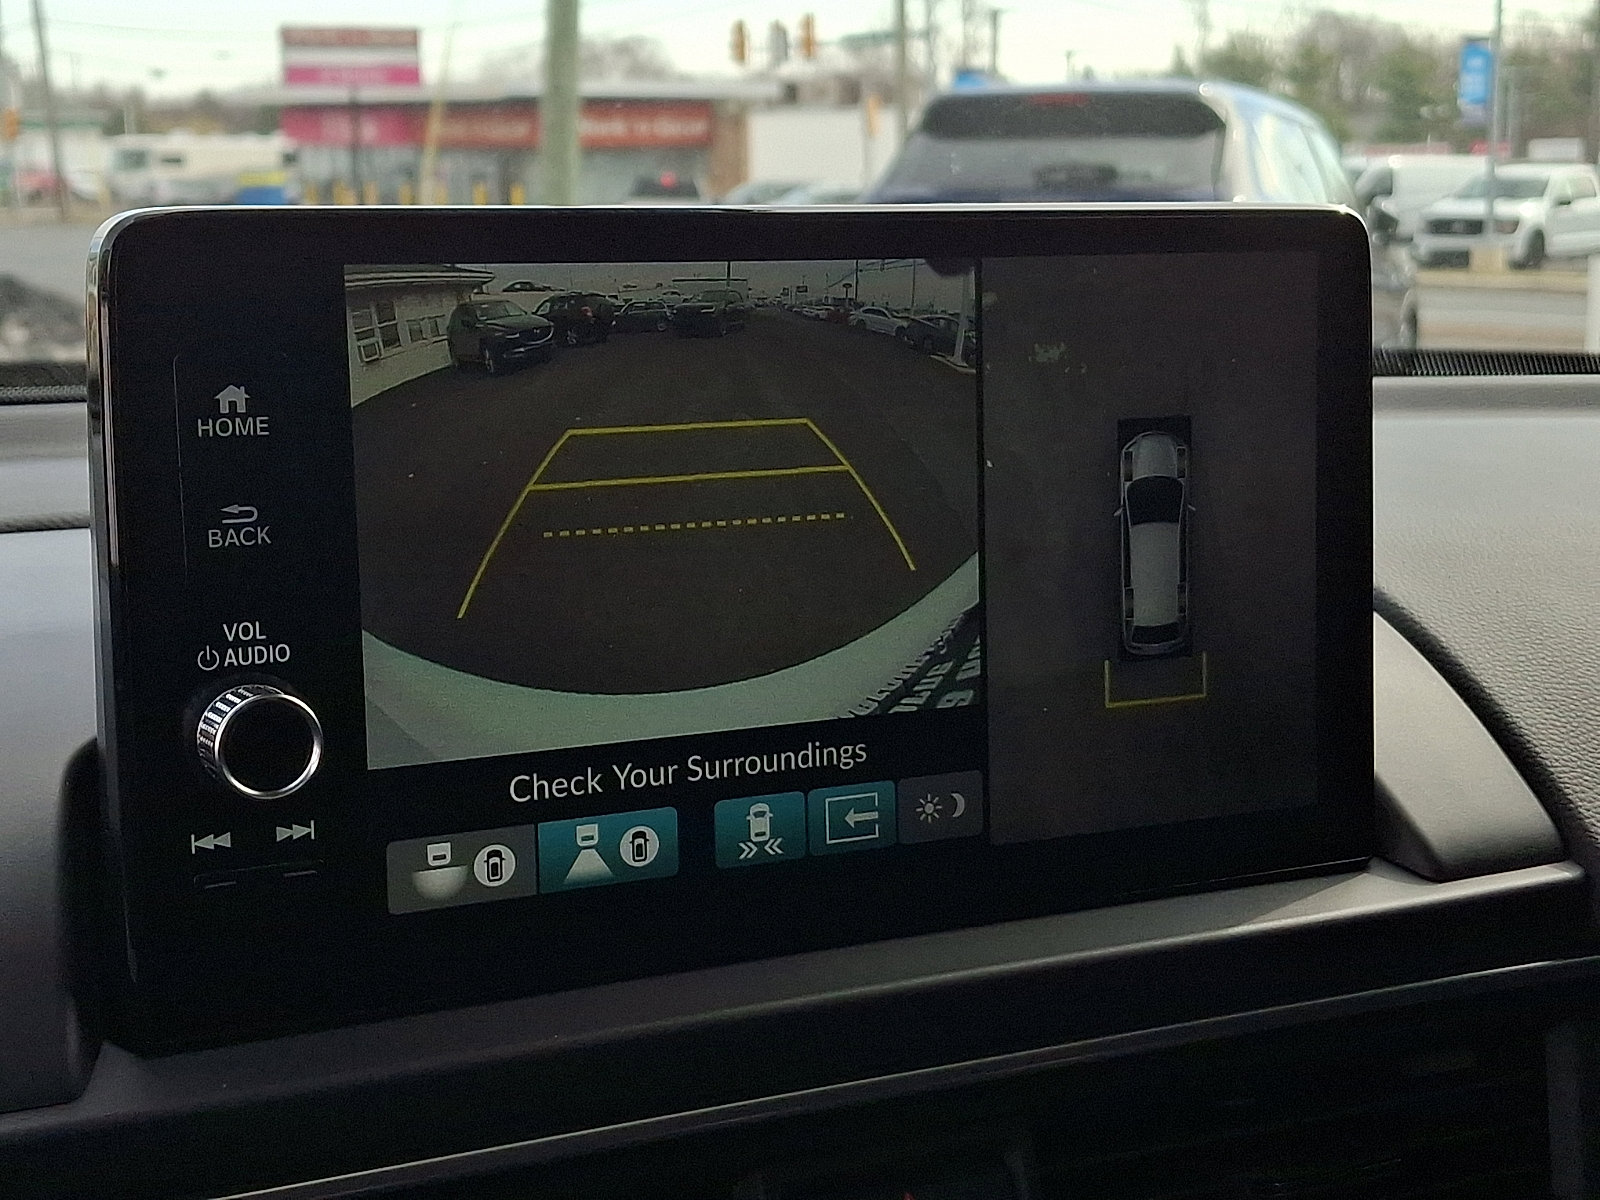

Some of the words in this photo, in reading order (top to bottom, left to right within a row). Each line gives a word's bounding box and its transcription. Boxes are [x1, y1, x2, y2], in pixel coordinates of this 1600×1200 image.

[198, 418, 270, 437] HOME
[208, 526, 272, 548] BACK
[222, 621, 267, 641] VOL
[224, 644, 291, 667] AUDIO
[508, 767, 604, 804] Check
[611, 761, 679, 791] Your
[686, 741, 867, 782] Surroundings
